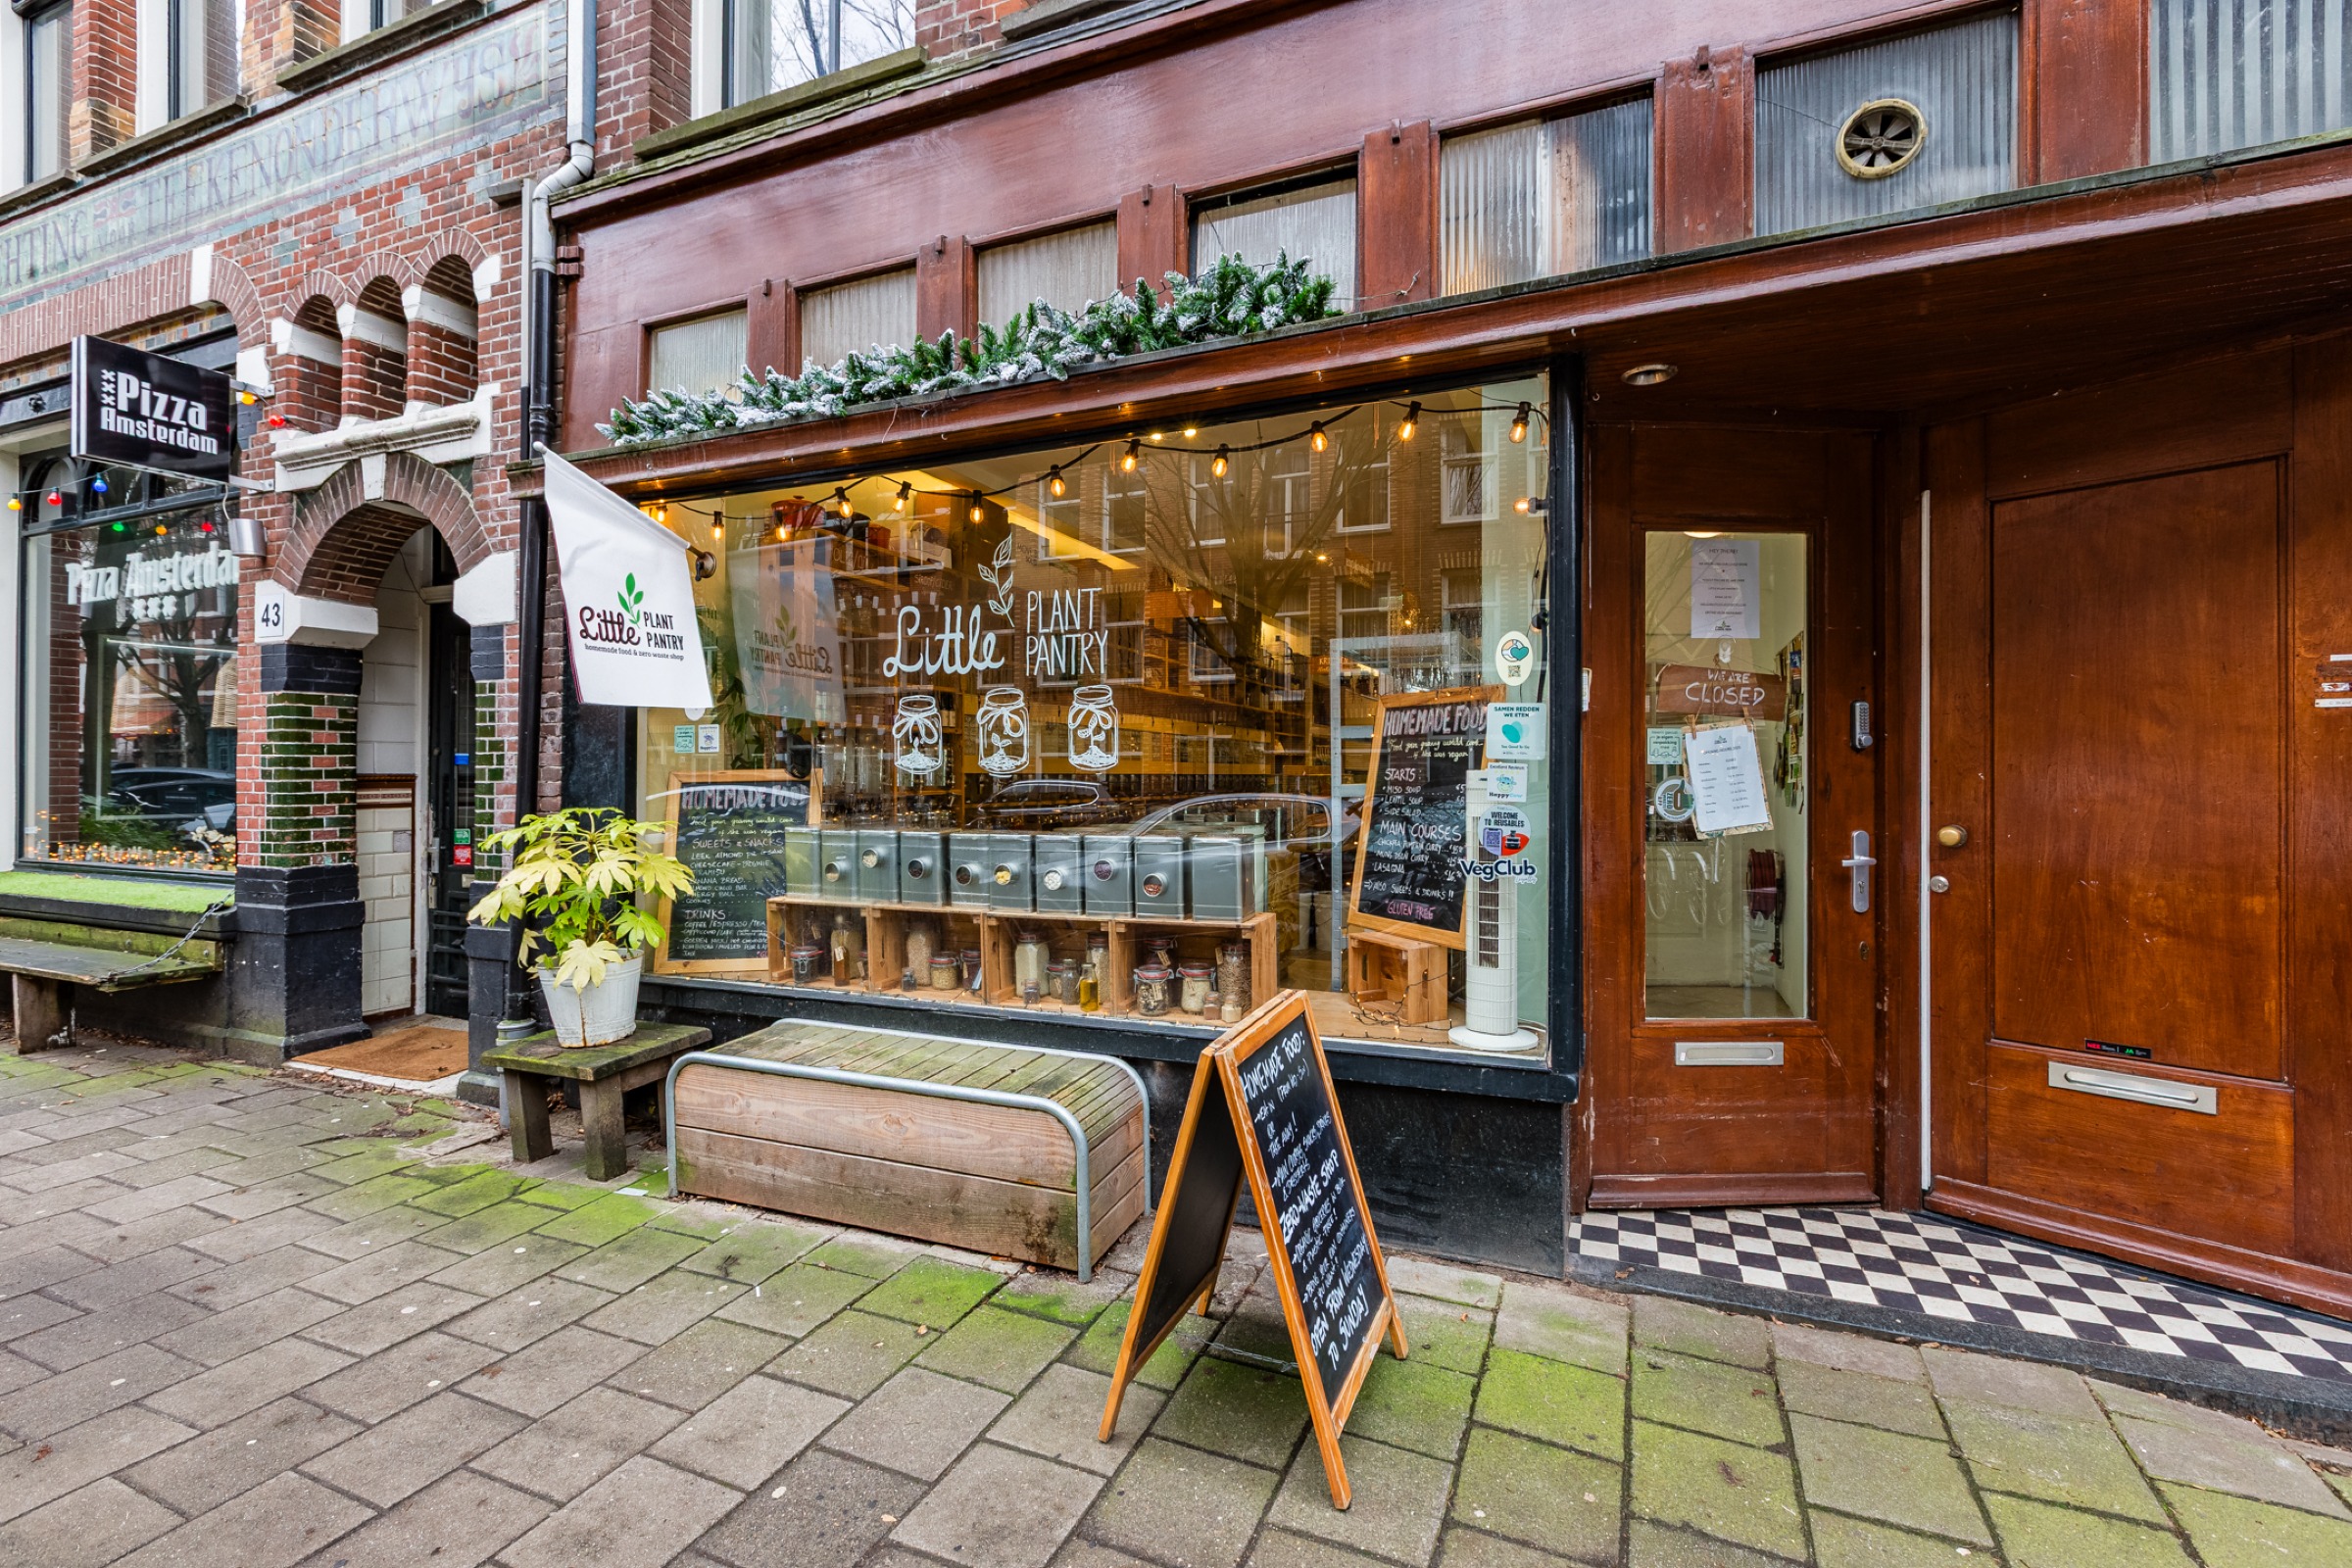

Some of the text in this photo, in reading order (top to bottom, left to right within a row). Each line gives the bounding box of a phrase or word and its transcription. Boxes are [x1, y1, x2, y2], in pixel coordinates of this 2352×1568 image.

[0, 210, 88, 289] HTING
[117, 371, 207, 431] Pizza
[100, 406, 219, 455] Amsterdam
[65, 560, 120, 605] Pizza
[261, 603, 281, 627] 43
[643, 611, 673, 629] PLANT
[1026, 588, 1102, 634] PLANT
[579, 606, 640, 646] Little
[584, 643, 617, 655] homemade
[617, 647, 632, 656] food
[669, 653, 684, 662] shop
[646, 632, 684, 651] PANTRY
[883, 605, 1005, 678] Little
[1025, 630, 1108, 676] PANTRY
[1708, 669, 1750, 684] WE ARE
[1686, 682, 1765, 706] CLOSED
[1383, 703, 1488, 737] HOMEMADE FOOD
[682, 787, 766, 809] HOMEMADE
[1405, 785, 1422, 794] SOUP
[1408, 796, 1423, 806] SOUP
[1401, 808, 1421, 817] SALAD
[1494, 818, 1525, 828] REUSABLES
[1380, 820, 1462, 842] MAIN COURSES
[693, 838, 732, 850] SWEETS
[745, 838, 784, 849] SNACKS
[1410, 855, 1429, 864] CURRY
[1460, 859, 1537, 881] VegClub
[1391, 883, 1412, 895] SWEETS
[1422, 888, 1446, 901] DRINKS
[686, 909, 726, 920] DRINKS
[1387, 901, 1437, 920] GLUTEN FREE
[1239, 1046, 1285, 1102] HOMEMADE
[1321, 1150, 1339, 1187] SHOP
[1310, 1311, 1329, 1357] OPEN
[1326, 1279, 1347, 1320] FROM
[1328, 1283, 1369, 1371] TO SUNDAY
